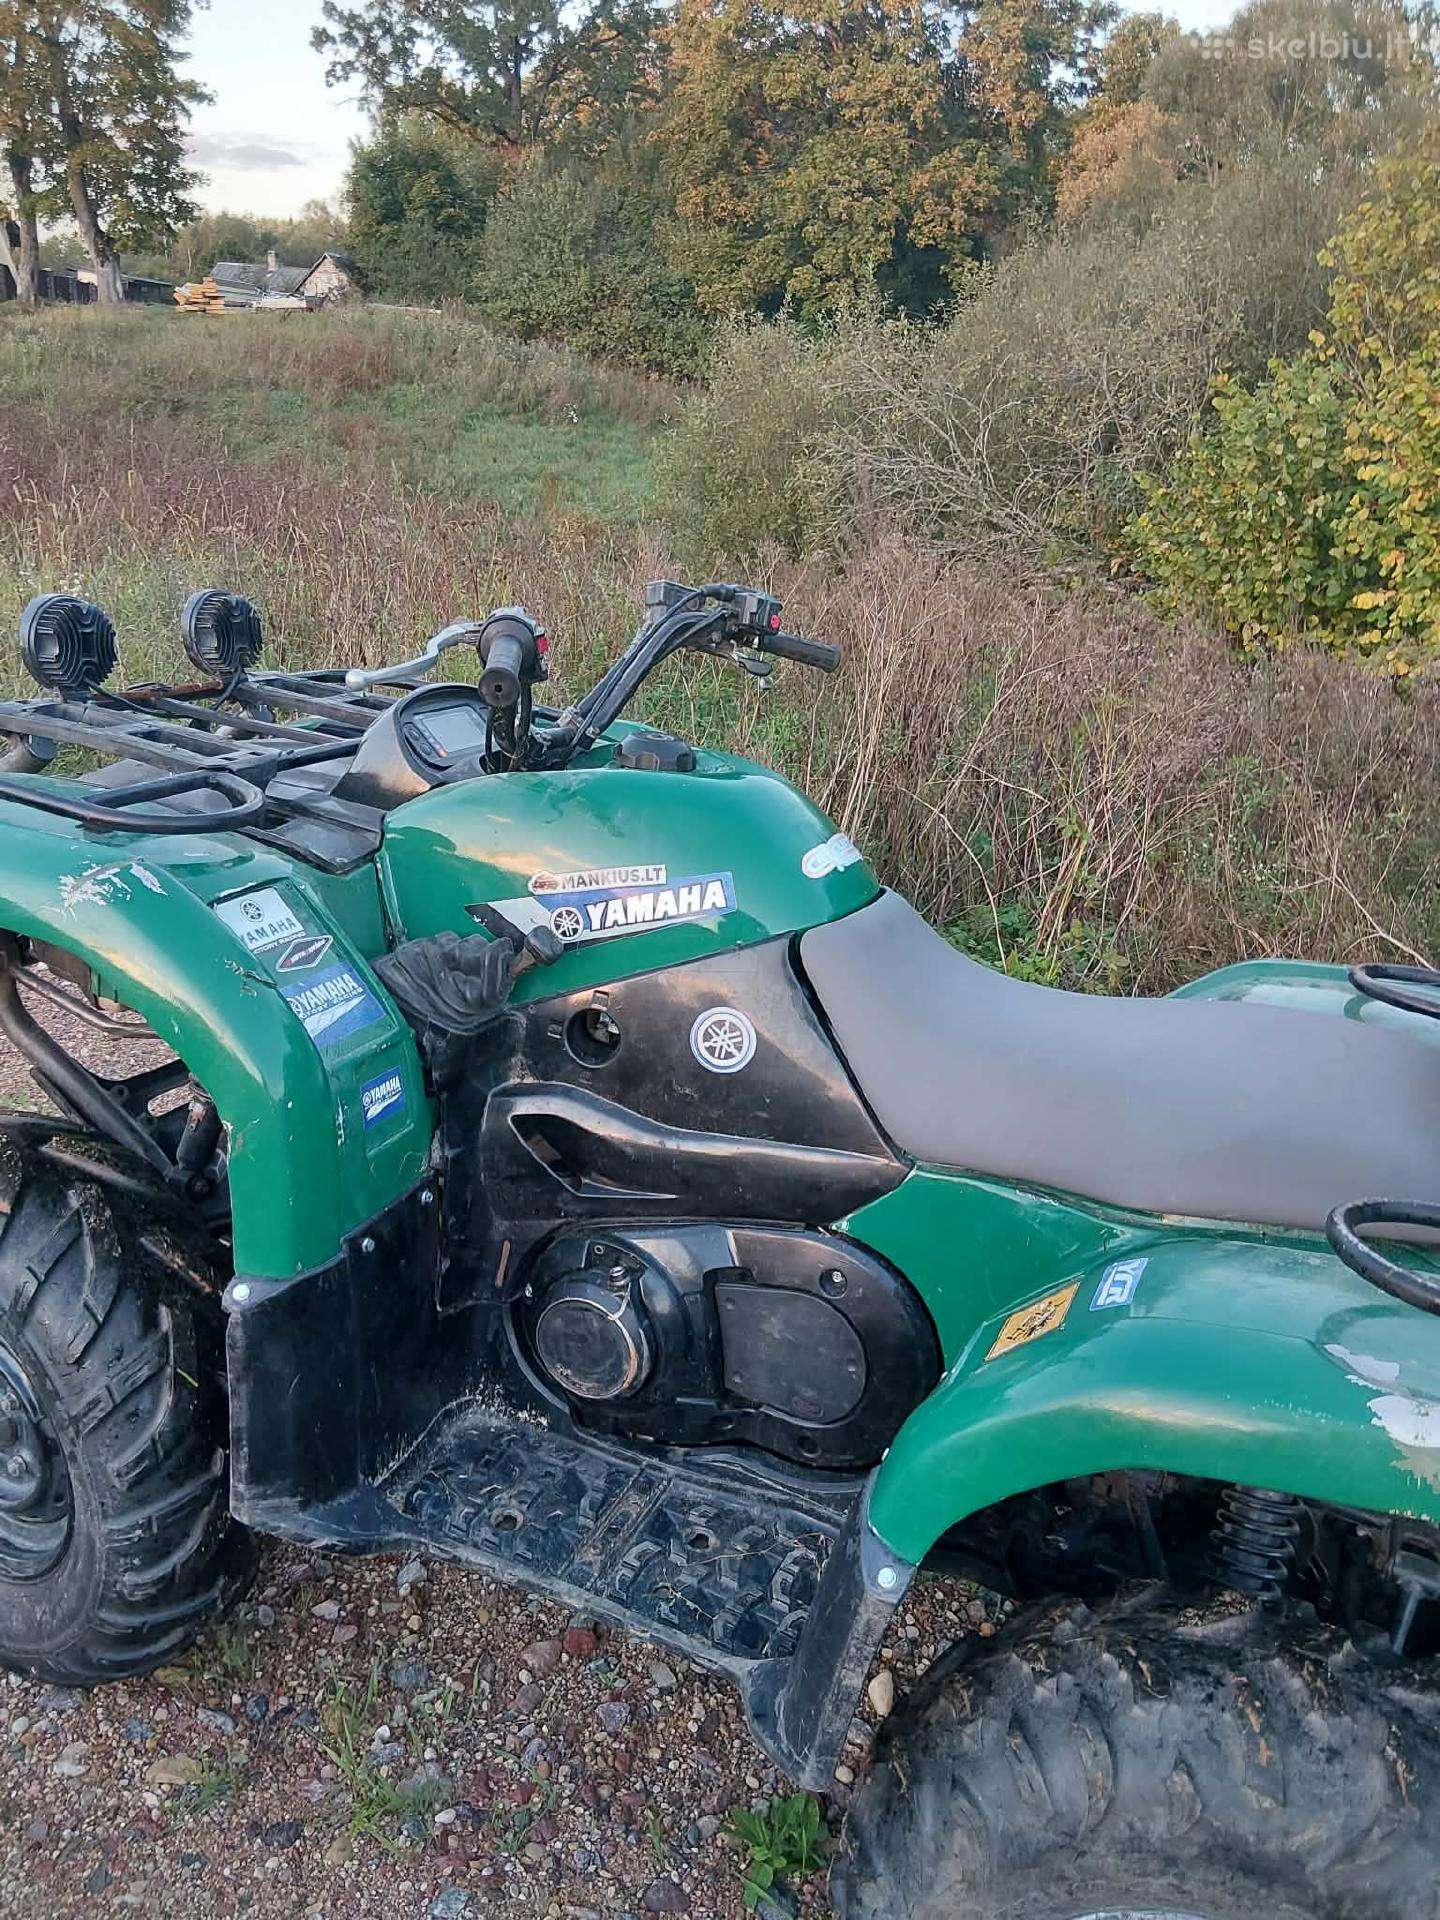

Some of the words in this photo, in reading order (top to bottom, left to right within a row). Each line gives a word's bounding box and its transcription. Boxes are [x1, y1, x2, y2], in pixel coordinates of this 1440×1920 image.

[561, 866, 663, 891] MANKIUS.LT
[586, 878, 728, 933] YAMAHA
[296, 973, 359, 1012] YAMAHA
[370, 1075, 401, 1104] YAMAHA
